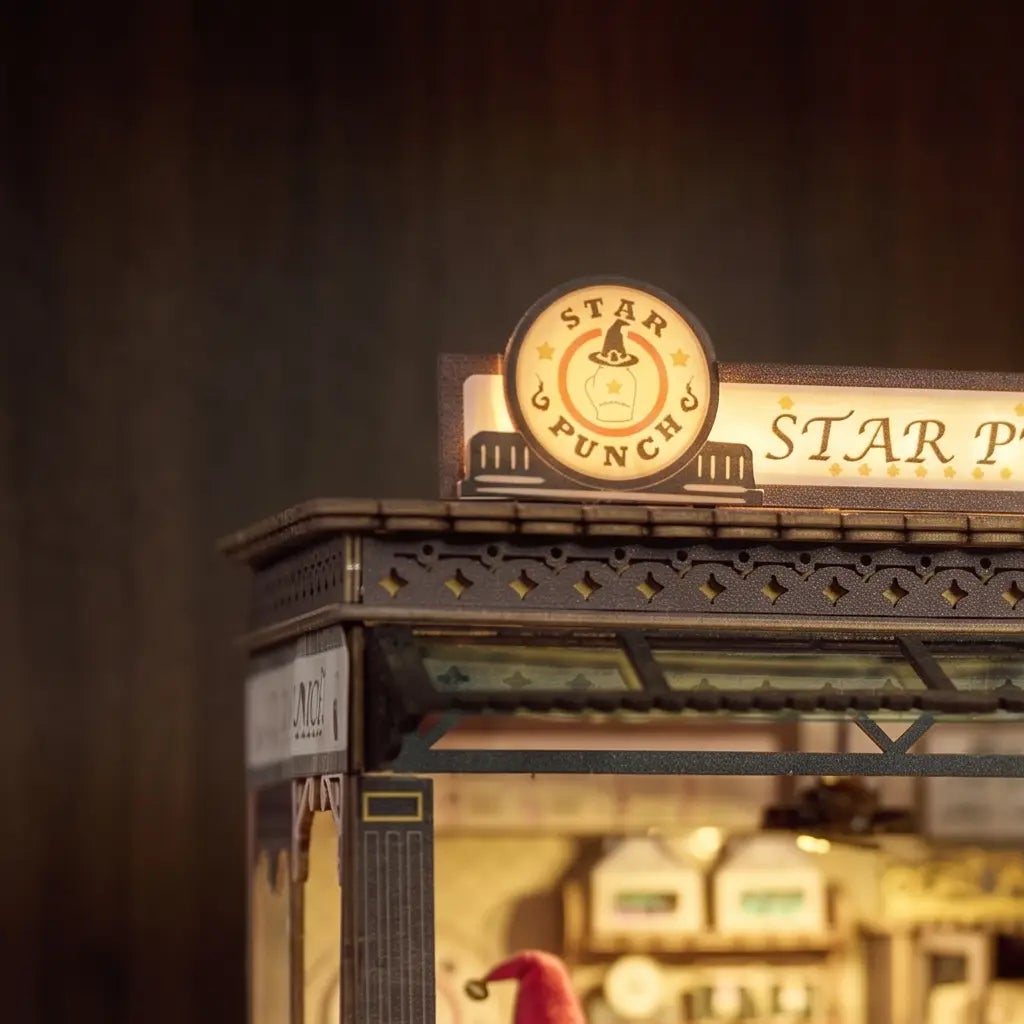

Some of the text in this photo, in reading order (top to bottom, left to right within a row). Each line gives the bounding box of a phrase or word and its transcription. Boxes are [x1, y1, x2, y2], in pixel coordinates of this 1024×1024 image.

[559, 297, 669, 339] STAR
[548, 414, 684, 468] PUNCH
[765, 409, 955, 464] STAR
